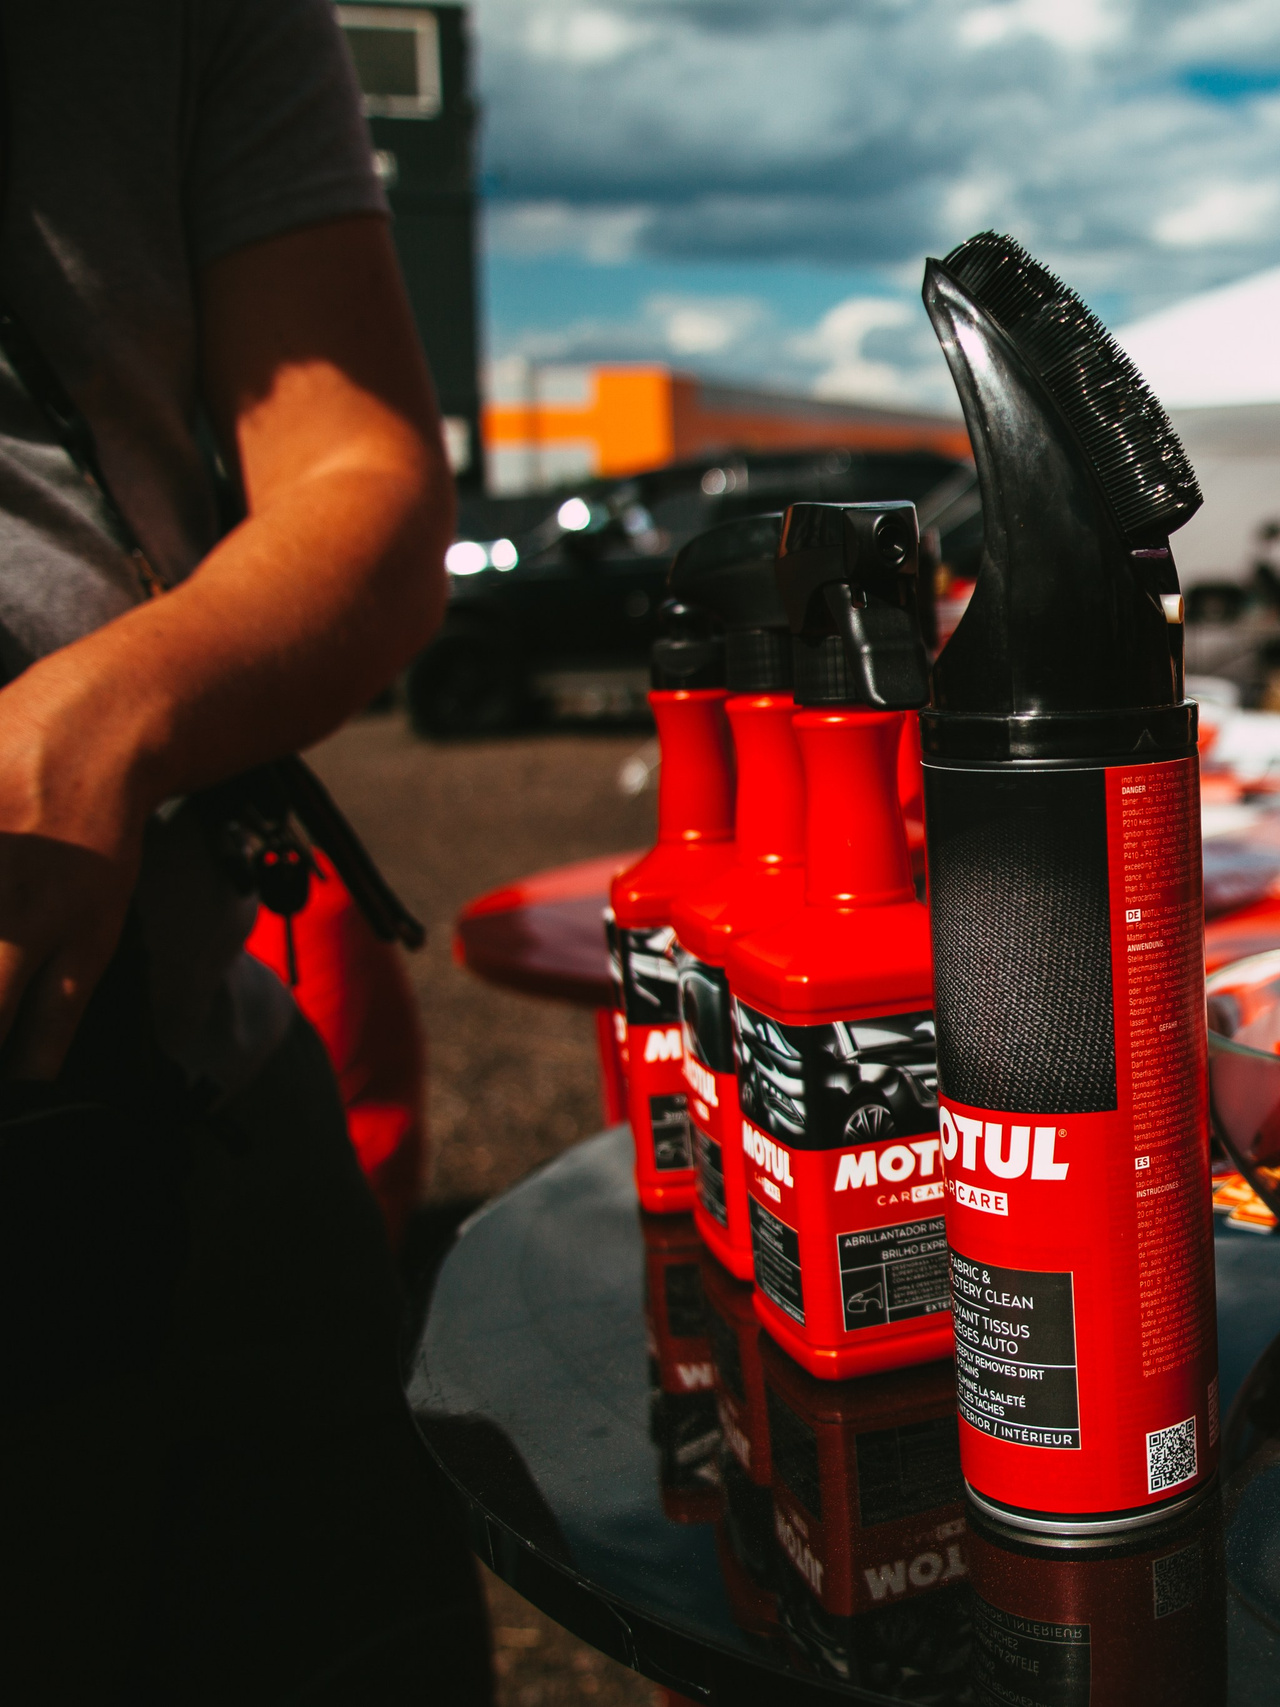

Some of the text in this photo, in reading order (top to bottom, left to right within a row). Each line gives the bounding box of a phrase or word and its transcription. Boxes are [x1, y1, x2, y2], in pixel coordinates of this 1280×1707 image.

[1121, 784, 1147, 795] DANGER
[742, 1119, 794, 1188] MOTUL
[939, 1105, 1070, 1181] OTUL
[834, 1139, 942, 1192] MOT
[844, 1219, 946, 1248] ABRILLANTADOR INS
[881, 1244, 919, 1260] BRILHO
[950, 1252, 980, 1281] FABRIC
[981, 1270, 991, 1285] &
[949, 1267, 983, 1299] OLSTERY
[984, 1289, 1034, 1310] CLEAN
[952, 1299, 1031, 1339] OYANT TISSUS
[981, 1334, 1019, 1355] AUTO
[960, 1356, 980, 1379] STAINS
[975, 1355, 1018, 1377] REMOVES
[1019, 1369, 1045, 1380] DIRT
[964, 1388, 974, 1404] LES
[974, 1396, 1006, 1417] TACHES
[978, 1385, 989, 1399] LA
[989, 1390, 1027, 1408] SALETÉ
[1001, 1425, 1073, 1445] INTÉRIEUR
